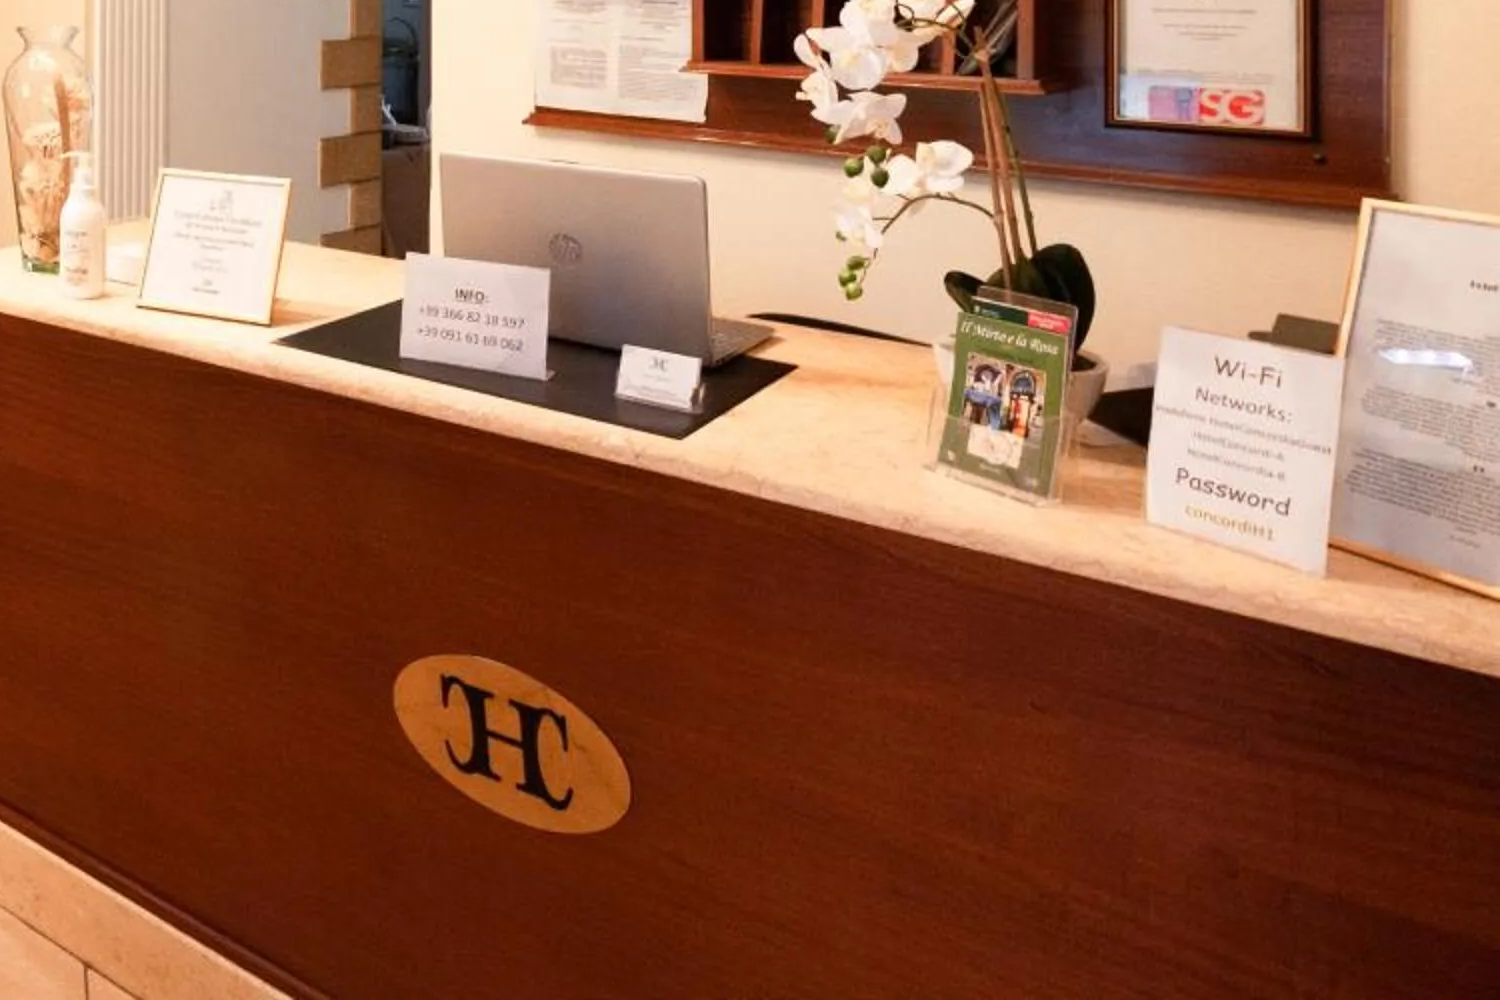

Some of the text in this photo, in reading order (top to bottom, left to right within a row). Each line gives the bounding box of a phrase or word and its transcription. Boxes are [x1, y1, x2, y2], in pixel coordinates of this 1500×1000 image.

[1213, 356, 1283, 388] Wi-Fi
[1195, 385, 1293, 424] Networks:
[1175, 466, 1292, 517] Password
